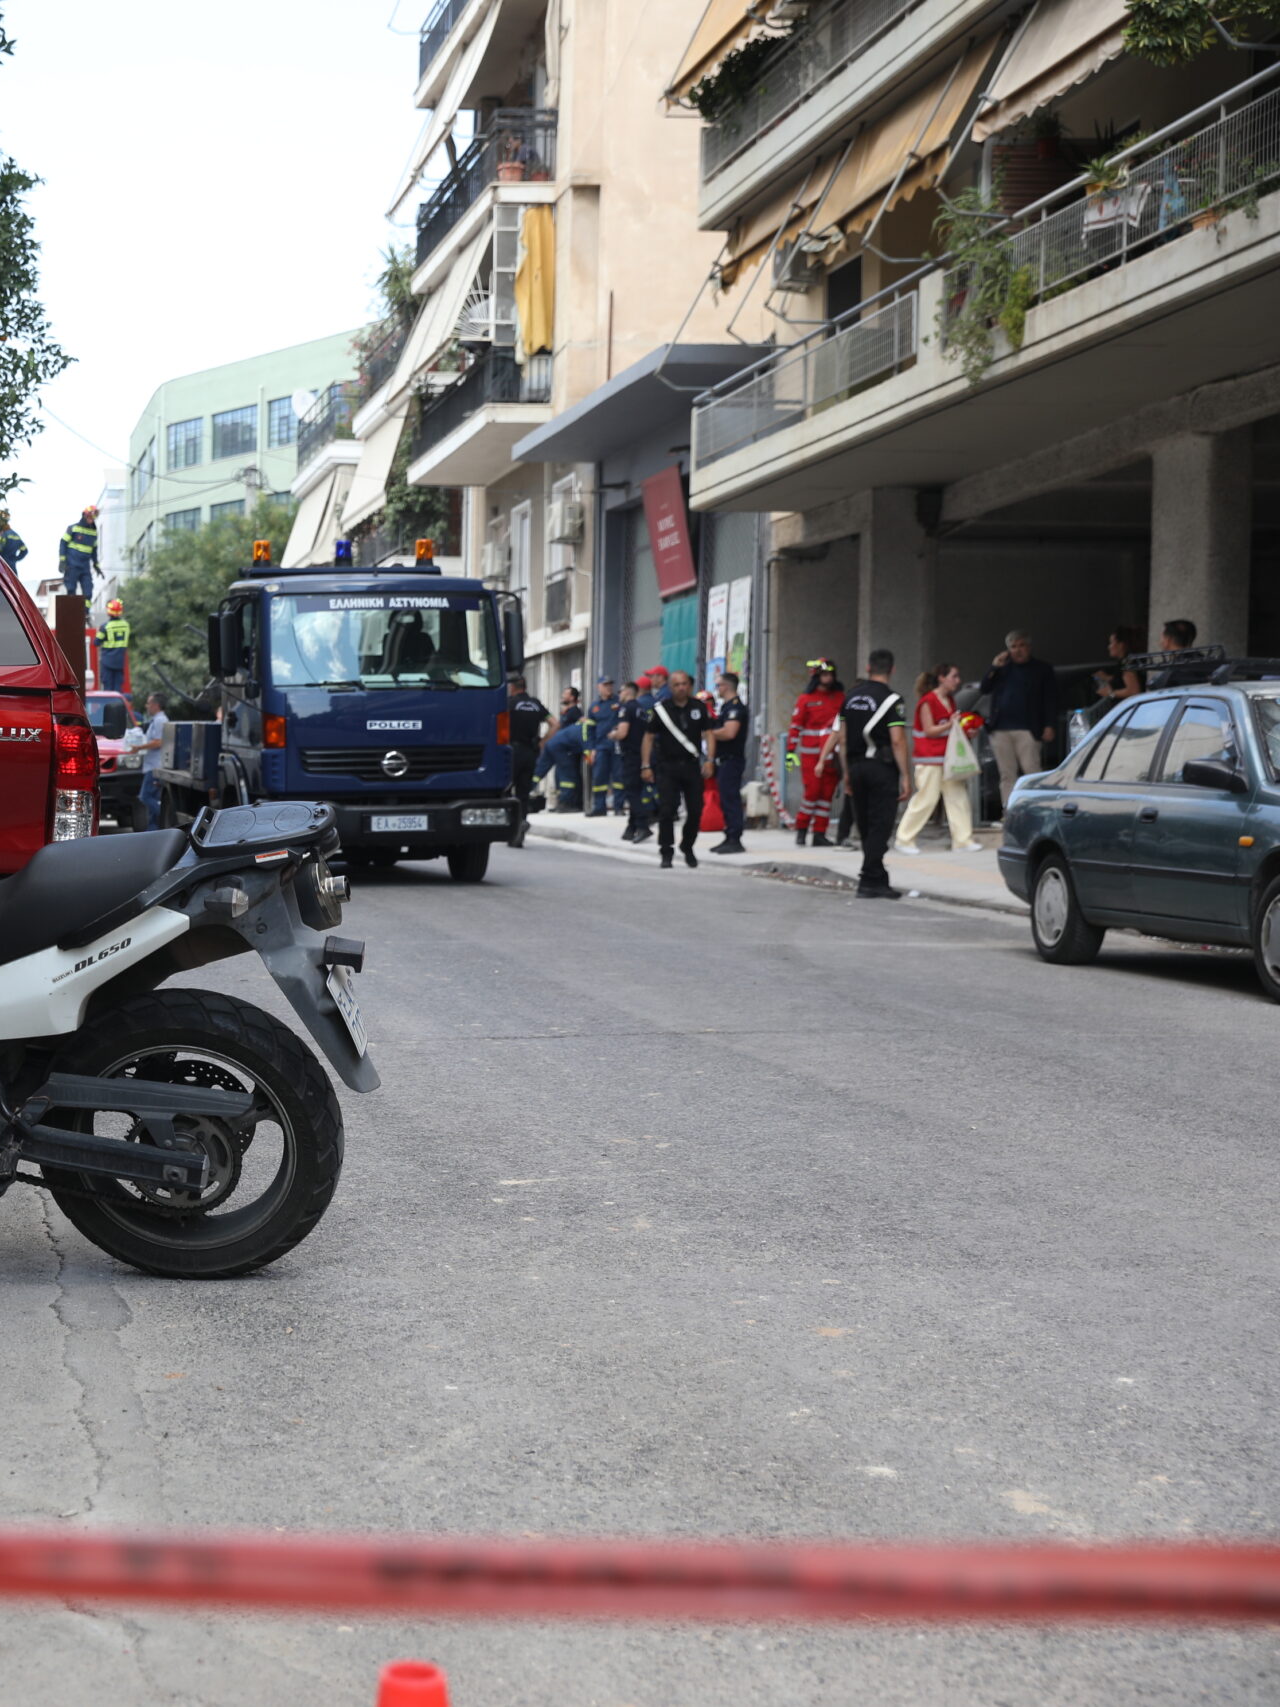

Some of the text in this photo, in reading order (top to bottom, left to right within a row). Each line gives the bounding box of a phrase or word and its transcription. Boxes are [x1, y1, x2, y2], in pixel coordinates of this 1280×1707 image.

[329, 598, 449, 609] ΕΛΛΗΝΙΚΗ ΑΣΤΥΝΟΜΙΑ
[74, 937, 131, 973] DL650
